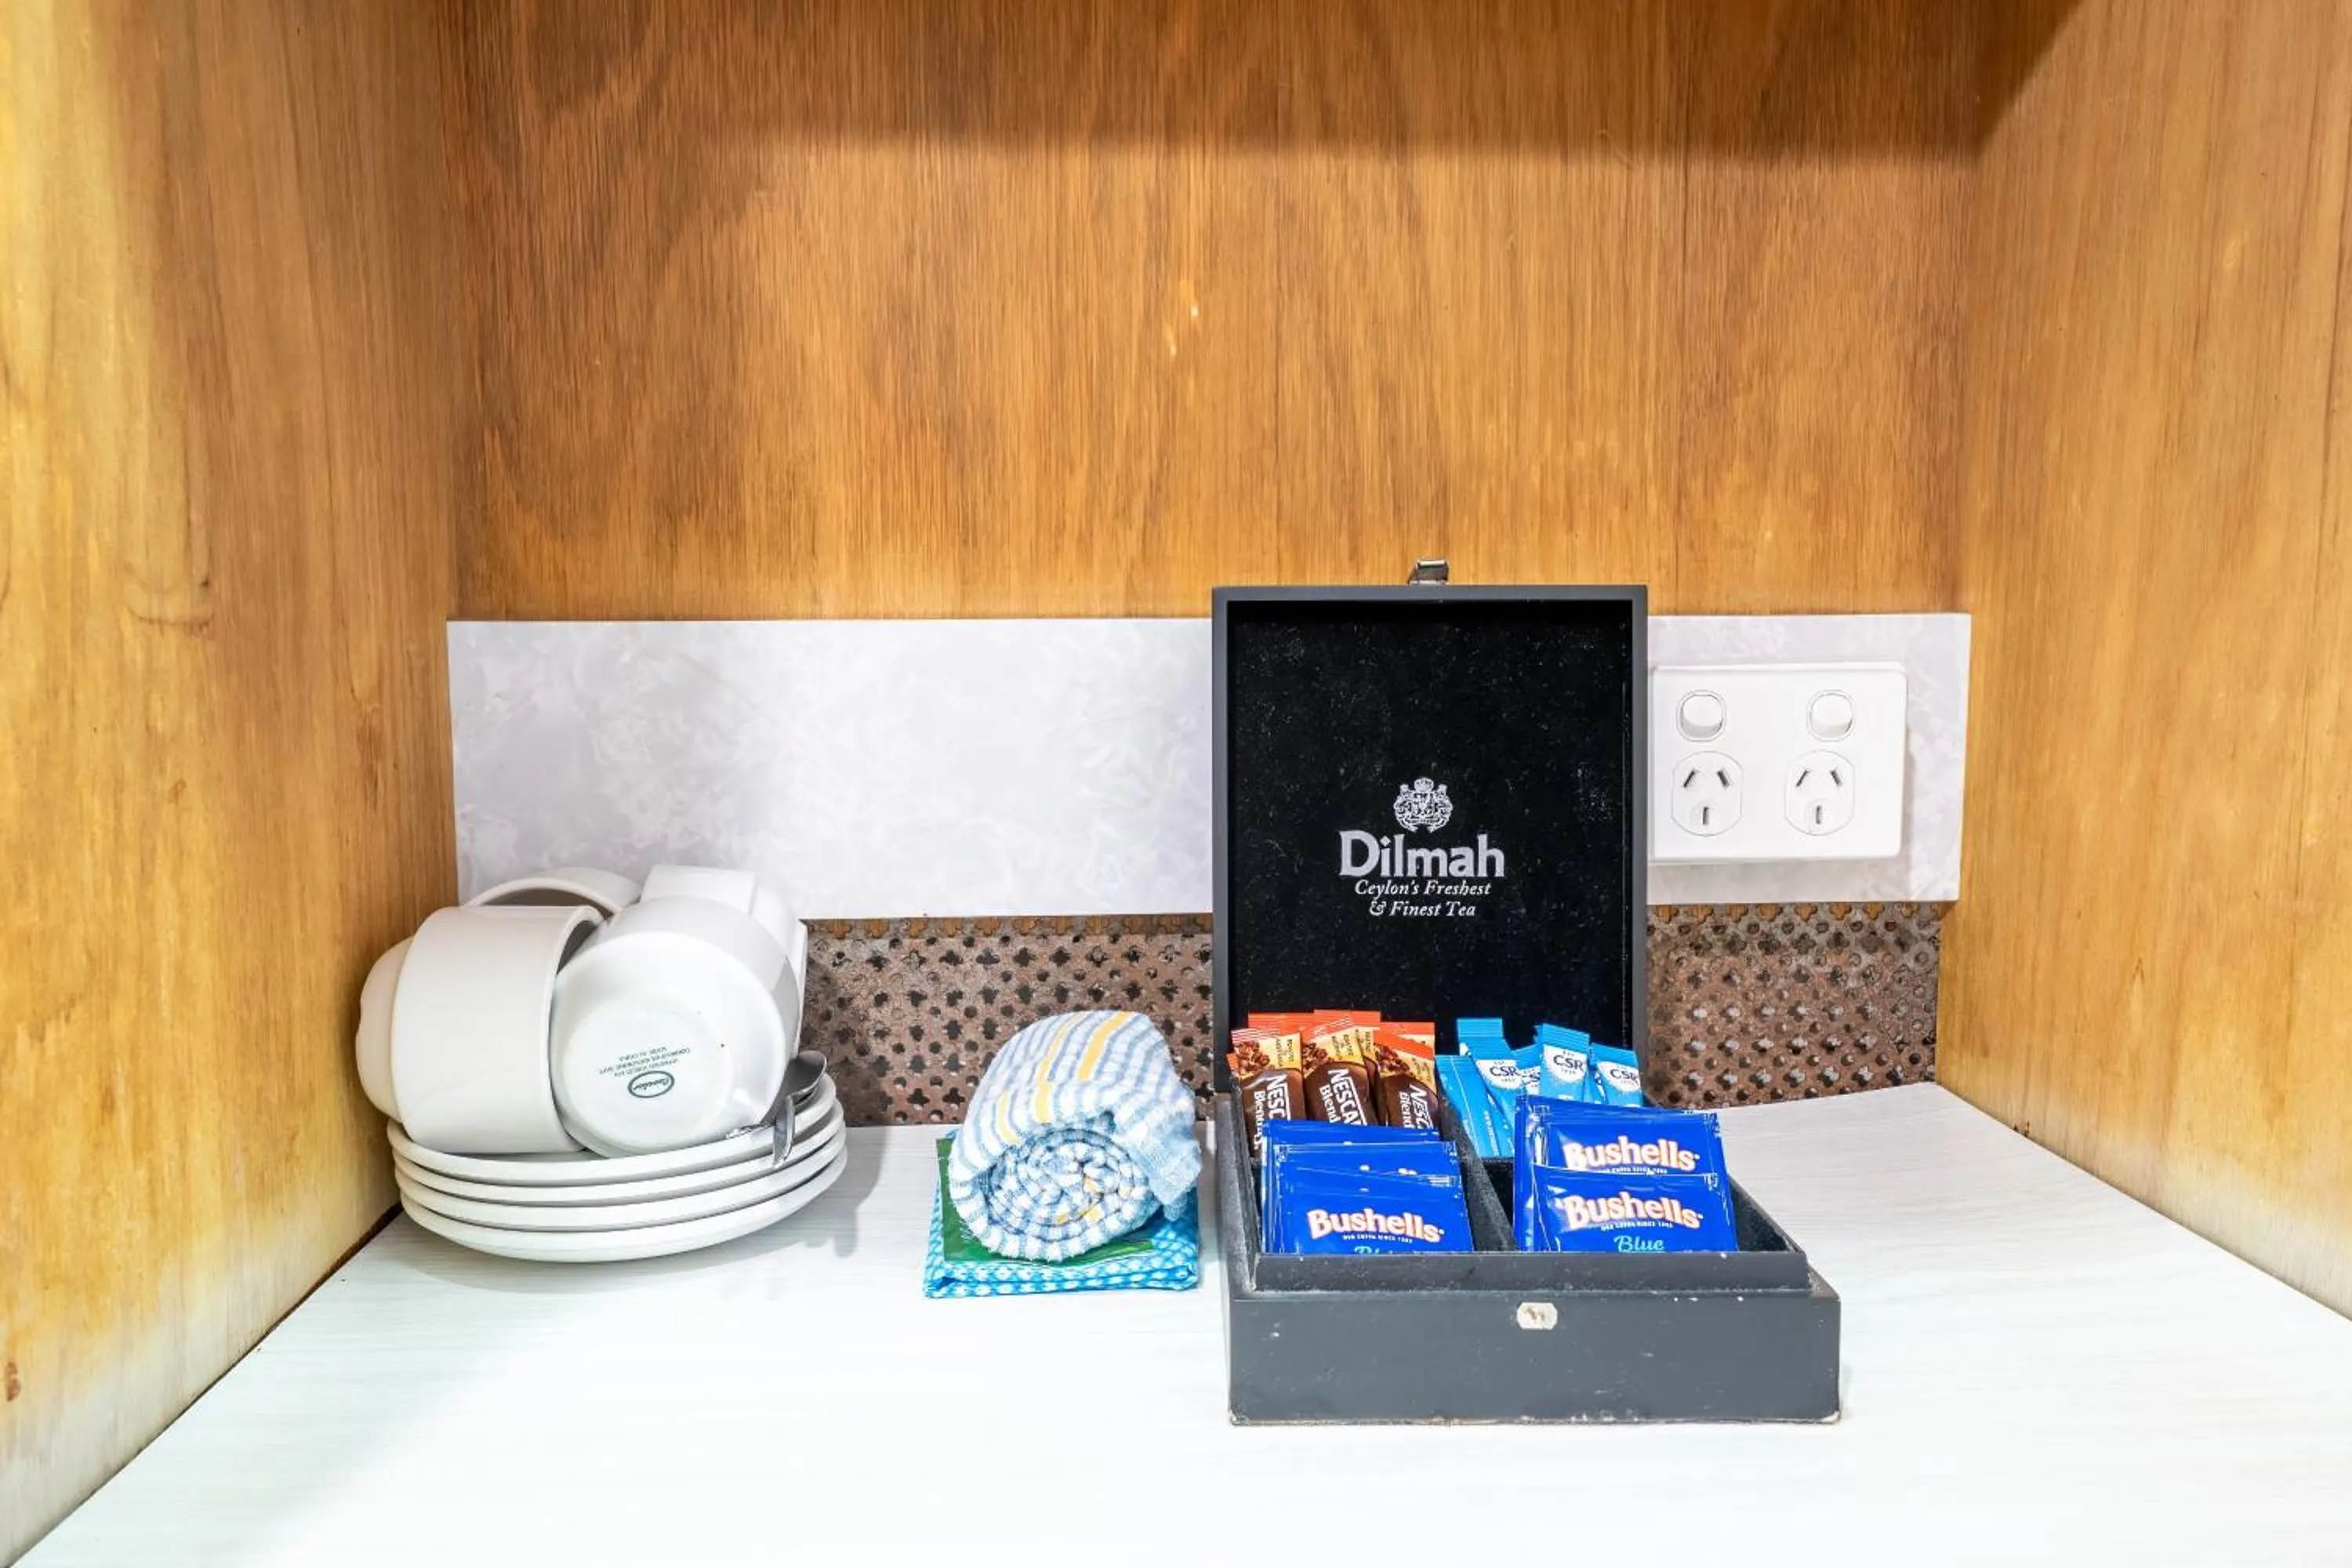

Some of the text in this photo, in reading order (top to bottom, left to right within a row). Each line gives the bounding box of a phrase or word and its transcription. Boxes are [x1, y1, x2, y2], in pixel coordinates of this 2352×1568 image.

[1338, 829, 1505, 877] Dilmah
[1355, 879, 1491, 900] Ceylon's Freshest
[1370, 901, 1476, 916] & Finest Tea
[1489, 1065, 1521, 1076] CSR
[1552, 1054, 1584, 1073] CSR
[1610, 1069, 1639, 1087] CSR
[1267, 1074, 1291, 1121] NESC
[1319, 1084, 1341, 1123] Blend
[1327, 1069, 1367, 1126] NESCA
[1398, 1091, 1416, 1128] Blend
[1409, 1083, 1434, 1129] NESC
[1563, 1135, 1696, 1171] Bushells
[1307, 1208, 1441, 1243] Bushells
[1564, 1192, 1700, 1229] Bushells
[1613, 1235, 1665, 1252] Blue
